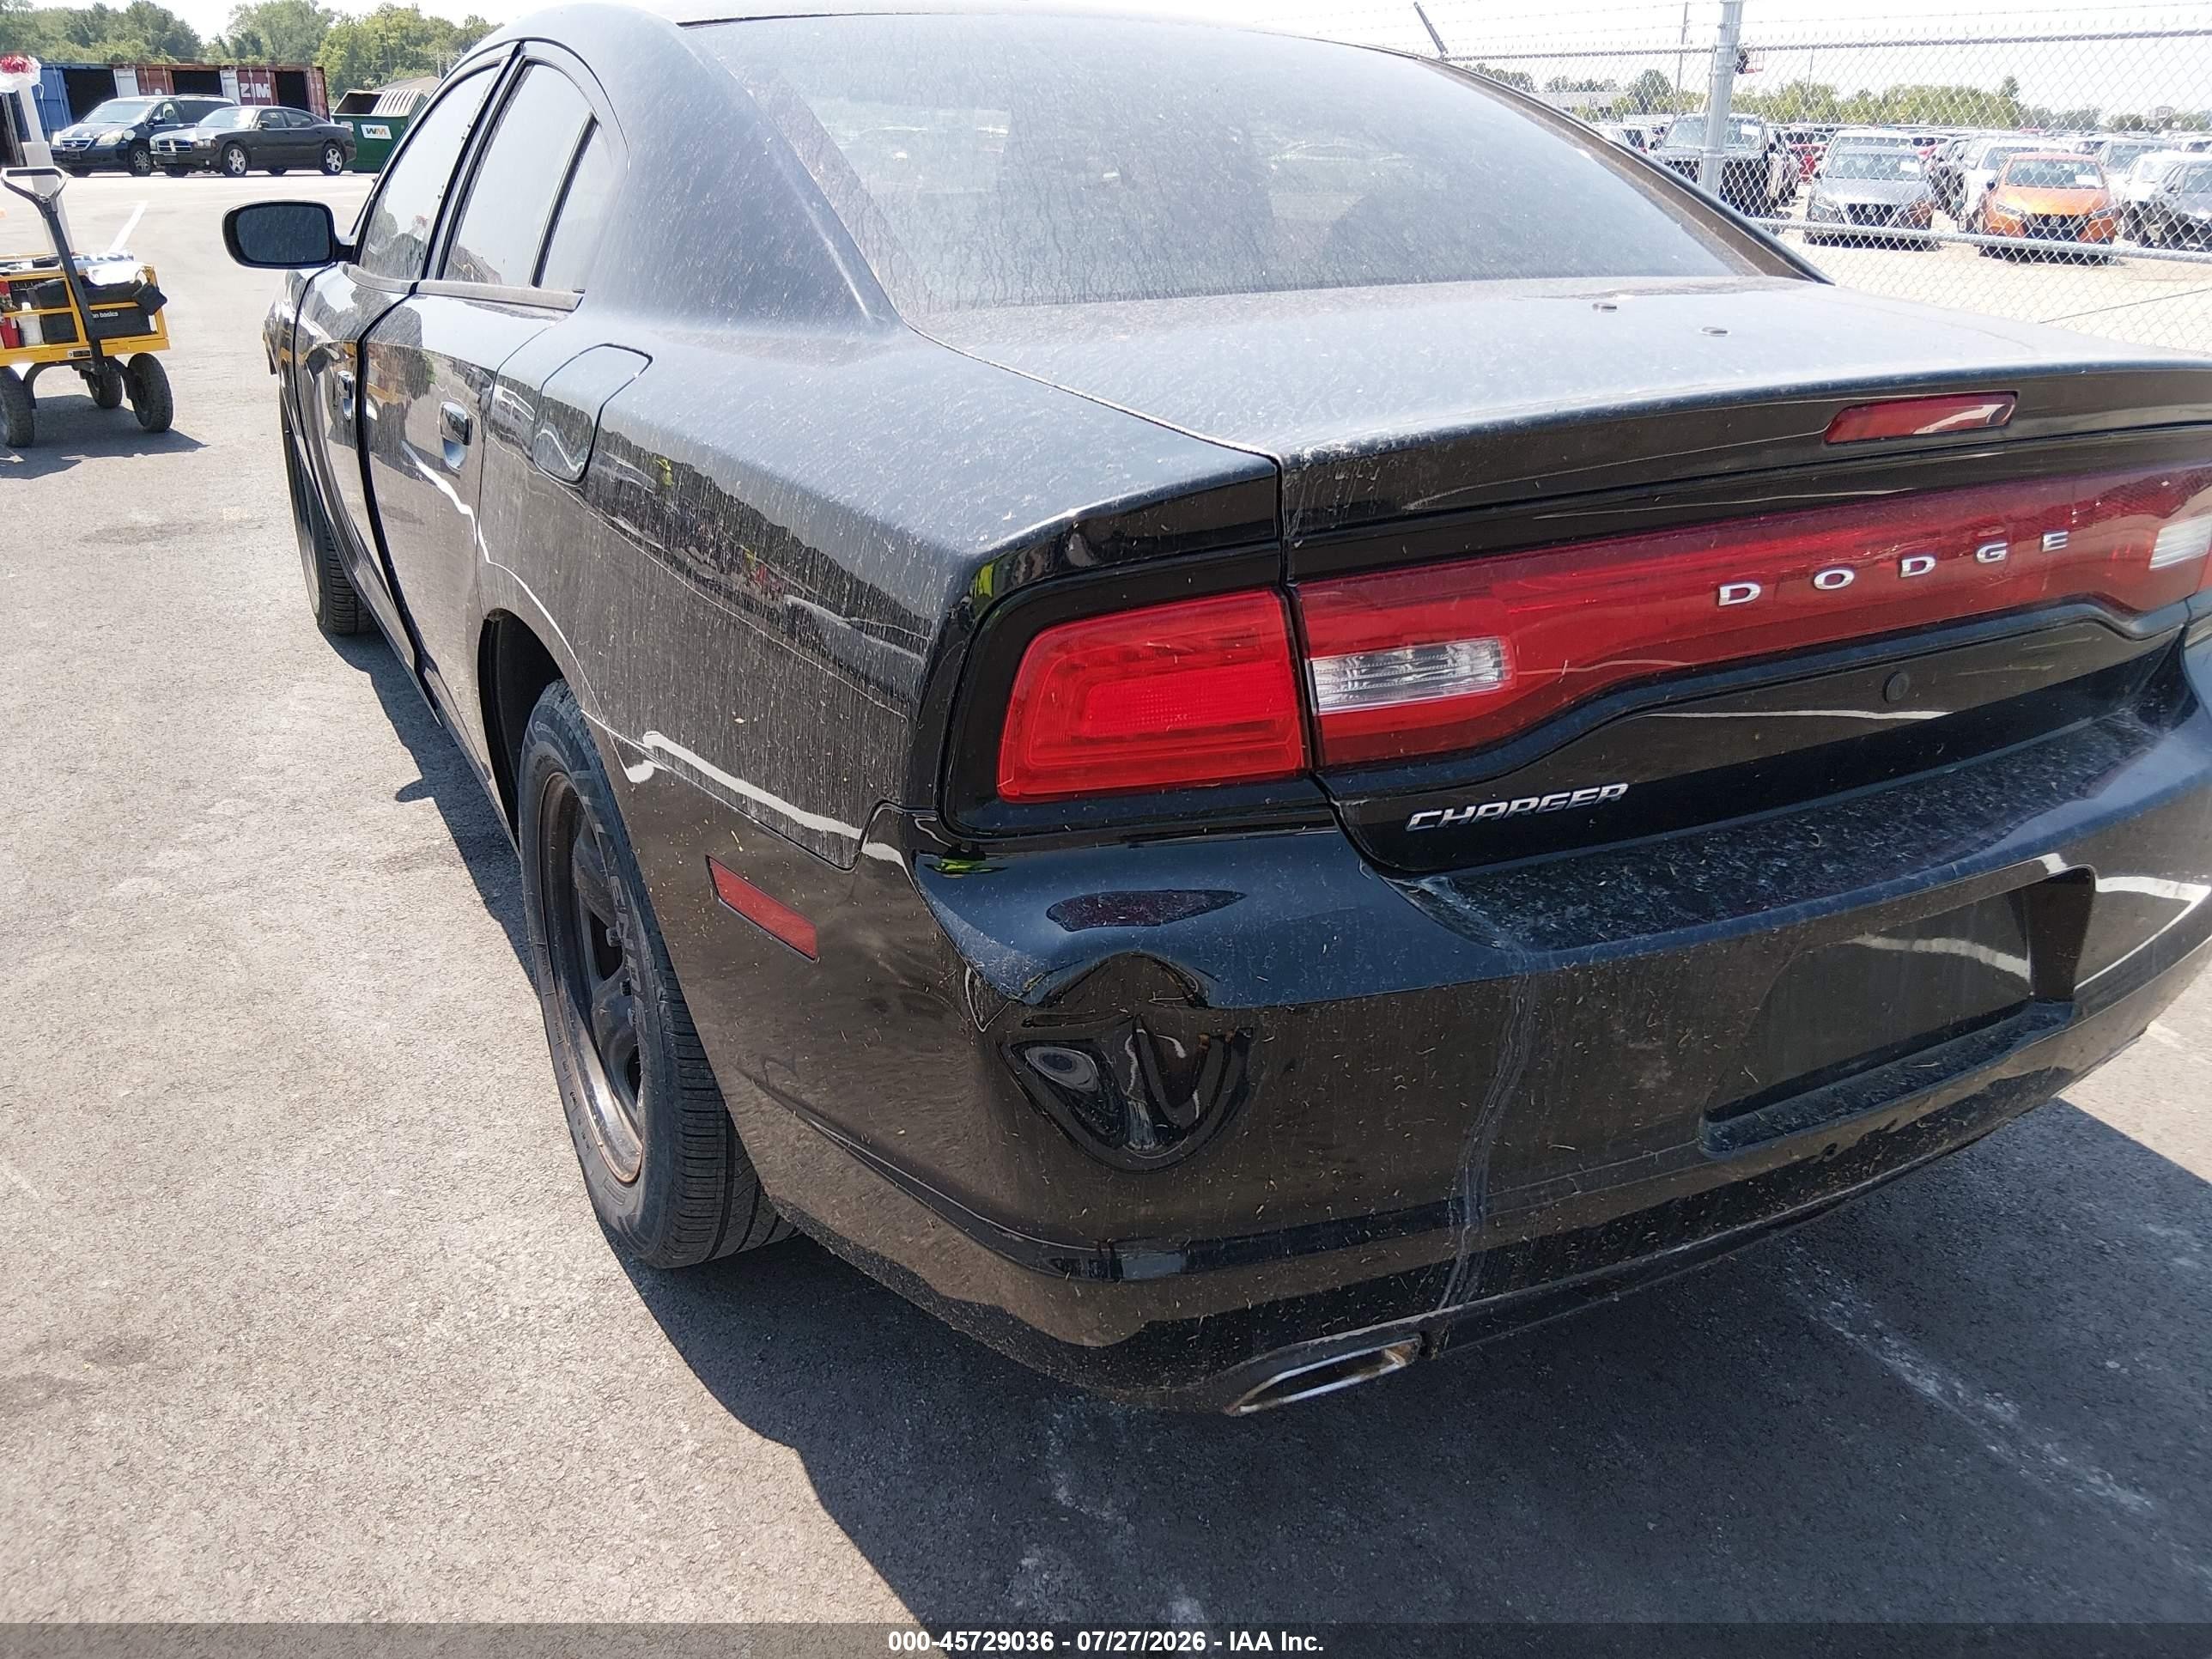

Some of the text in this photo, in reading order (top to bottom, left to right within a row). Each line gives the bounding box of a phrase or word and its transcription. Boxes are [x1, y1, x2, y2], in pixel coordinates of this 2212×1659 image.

[240, 83, 270, 98] ZIM
[1718, 531, 2069, 606] DODGE
[1405, 782, 1629, 832] CHARGER
